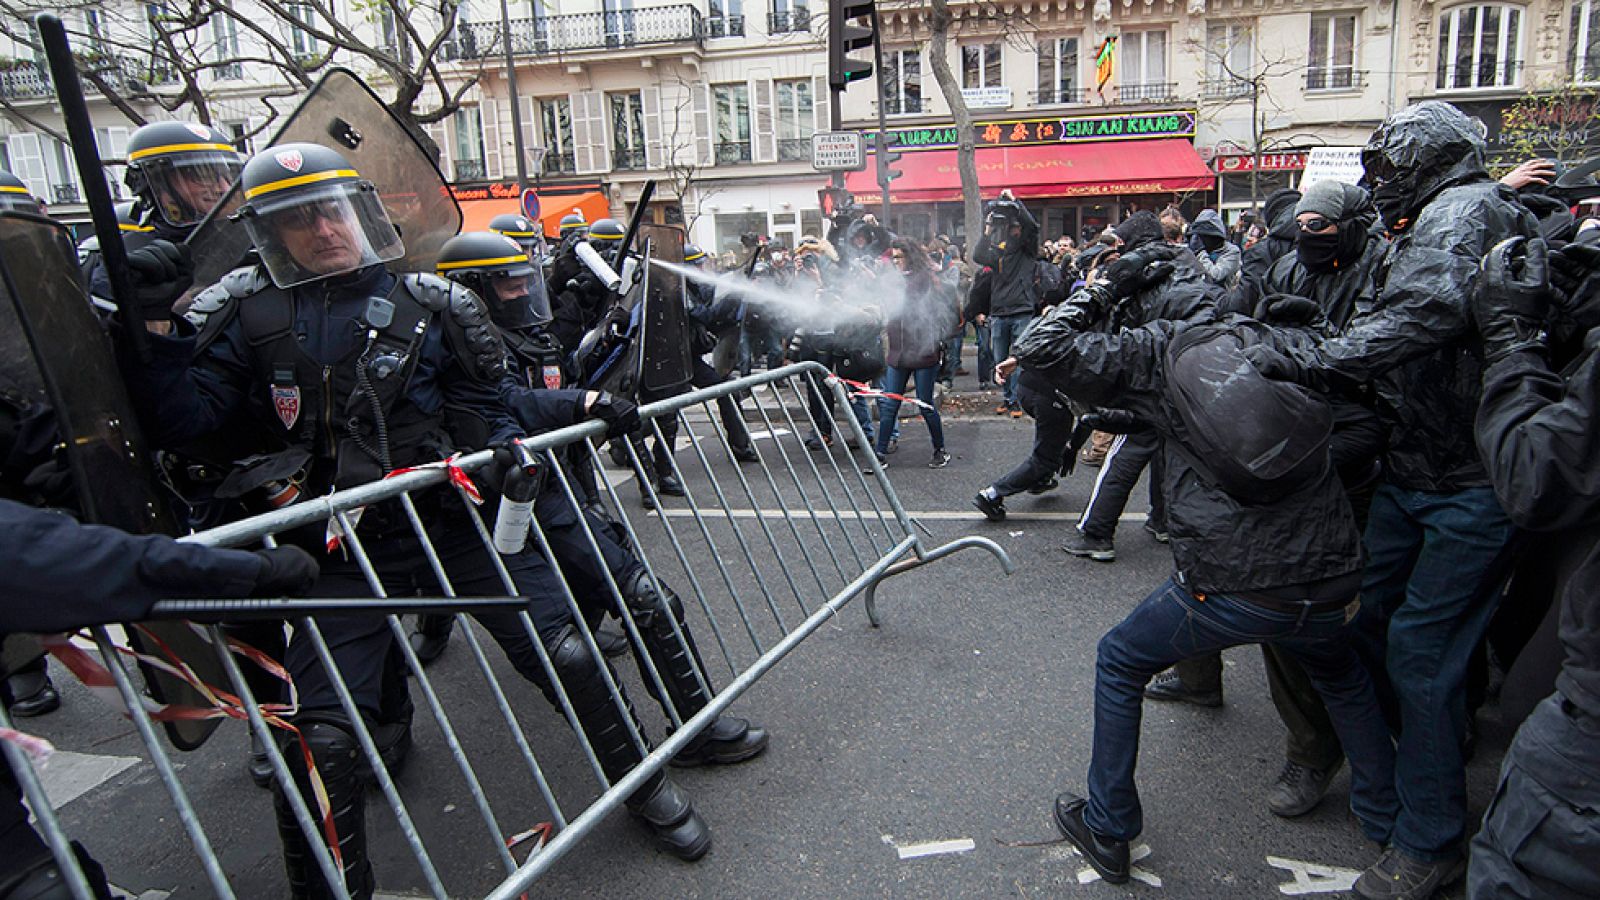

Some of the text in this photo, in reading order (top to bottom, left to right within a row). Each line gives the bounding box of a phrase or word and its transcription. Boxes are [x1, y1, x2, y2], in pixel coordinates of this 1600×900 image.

[1065, 115, 1179, 136] SIN AN KIANG
